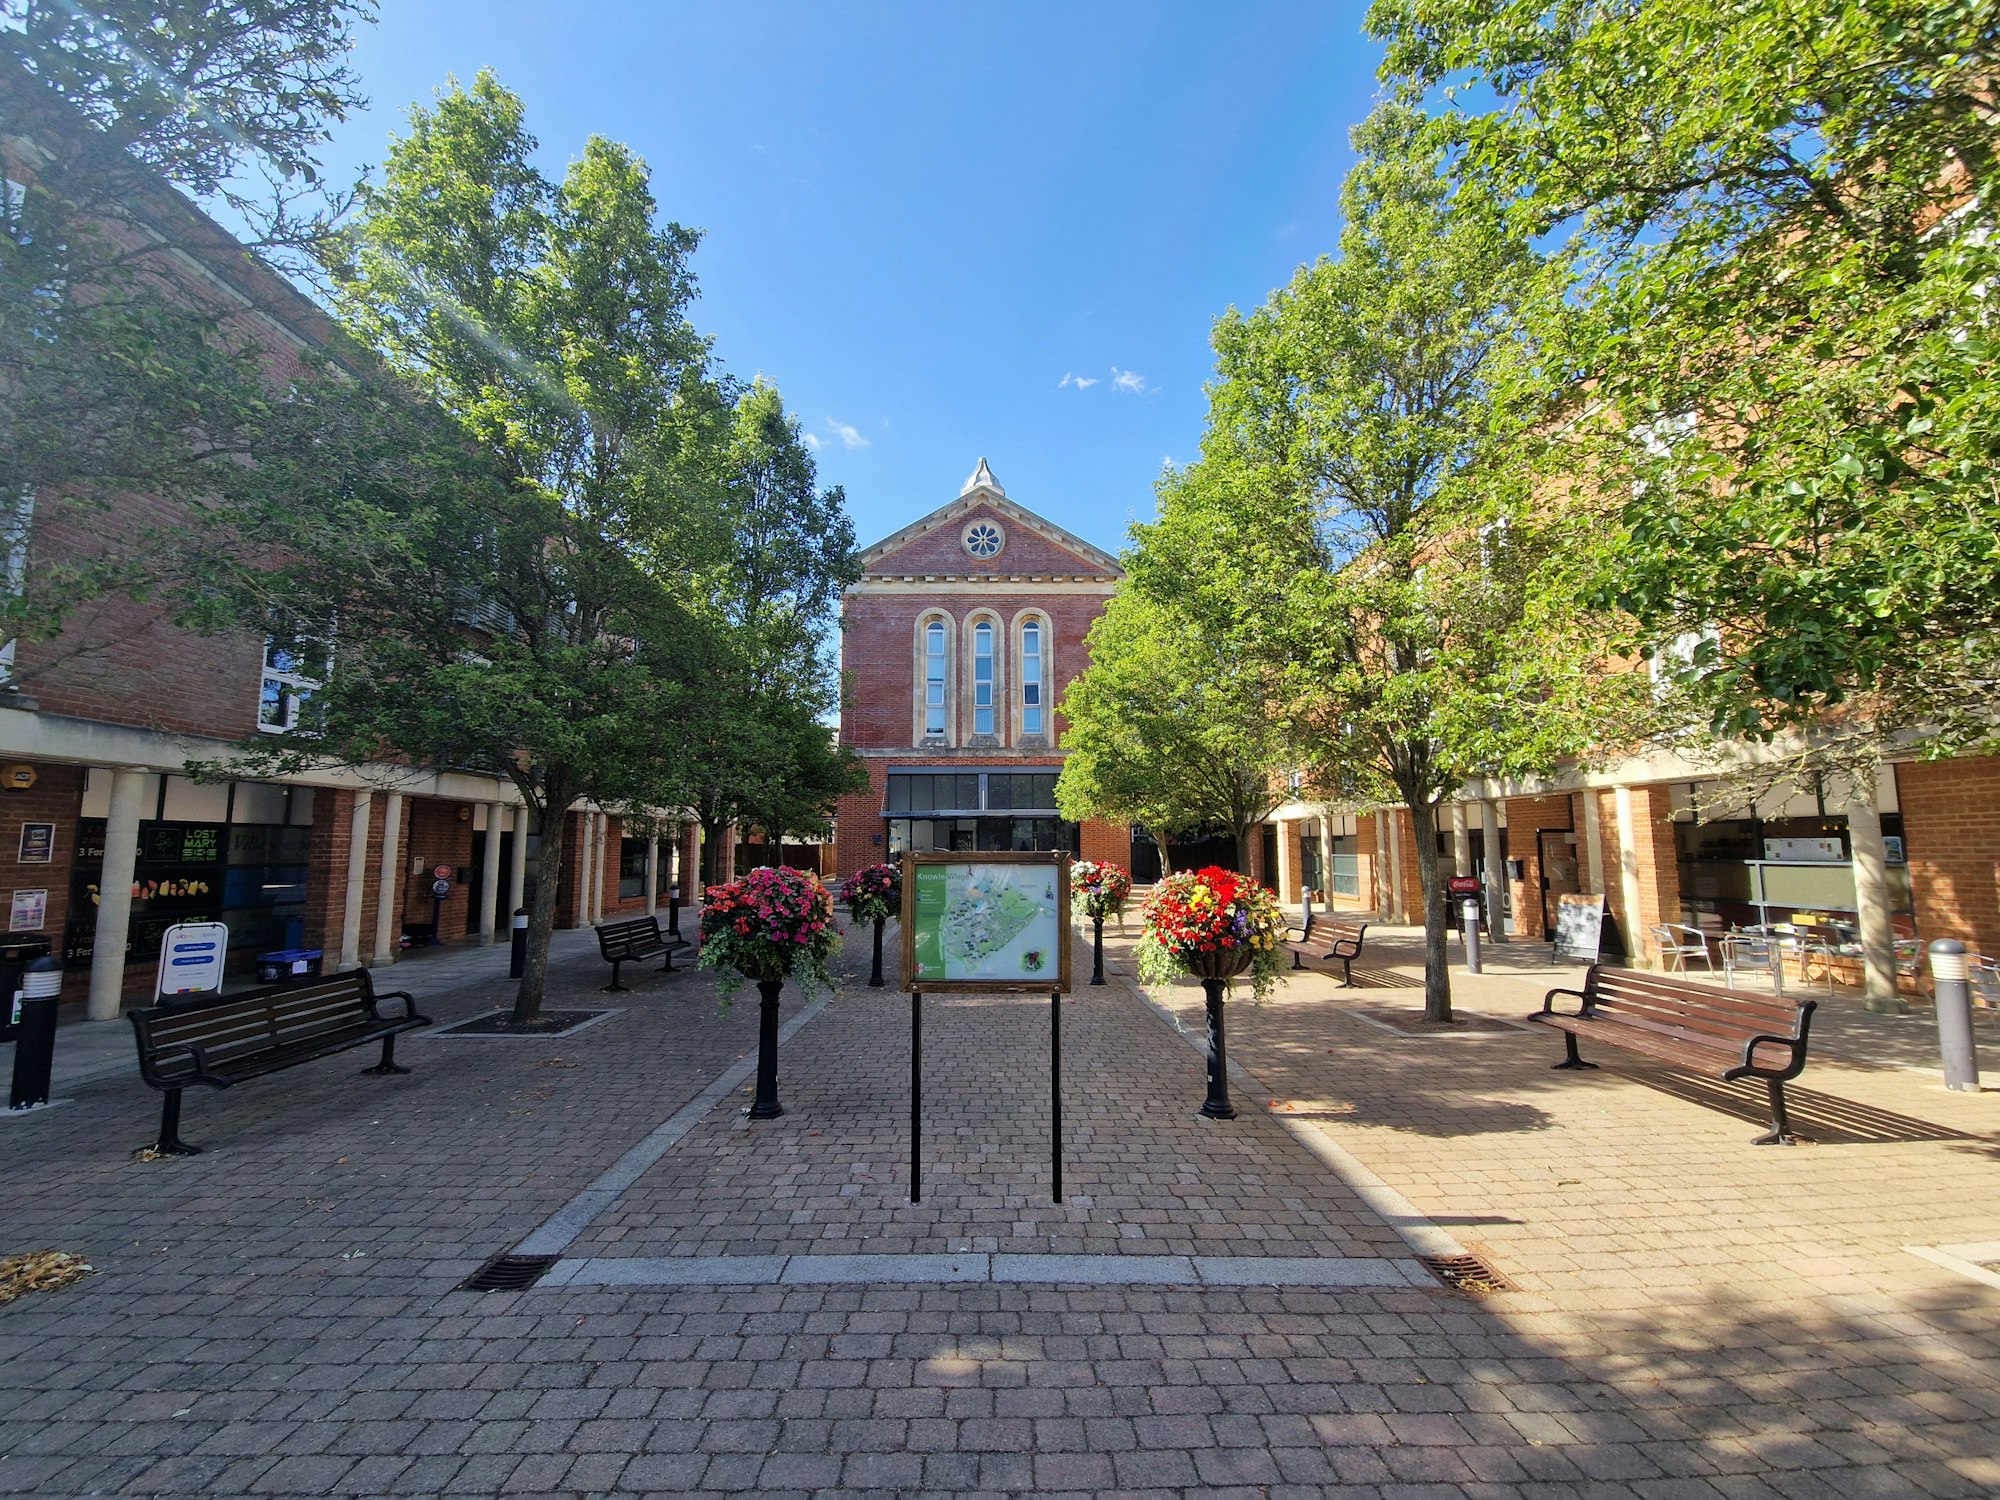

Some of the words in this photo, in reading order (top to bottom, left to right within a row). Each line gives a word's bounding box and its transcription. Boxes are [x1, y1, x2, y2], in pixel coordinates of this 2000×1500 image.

[185, 829, 217, 839] LOST
[183, 838, 217, 848] MARY
[78, 847, 85, 857] 3
[88, 847, 105, 857] For
[917, 872, 946, 881] Knowle
[946, 872, 970, 882] Village
[66, 948, 73, 958] 3
[76, 948, 93, 957] For
